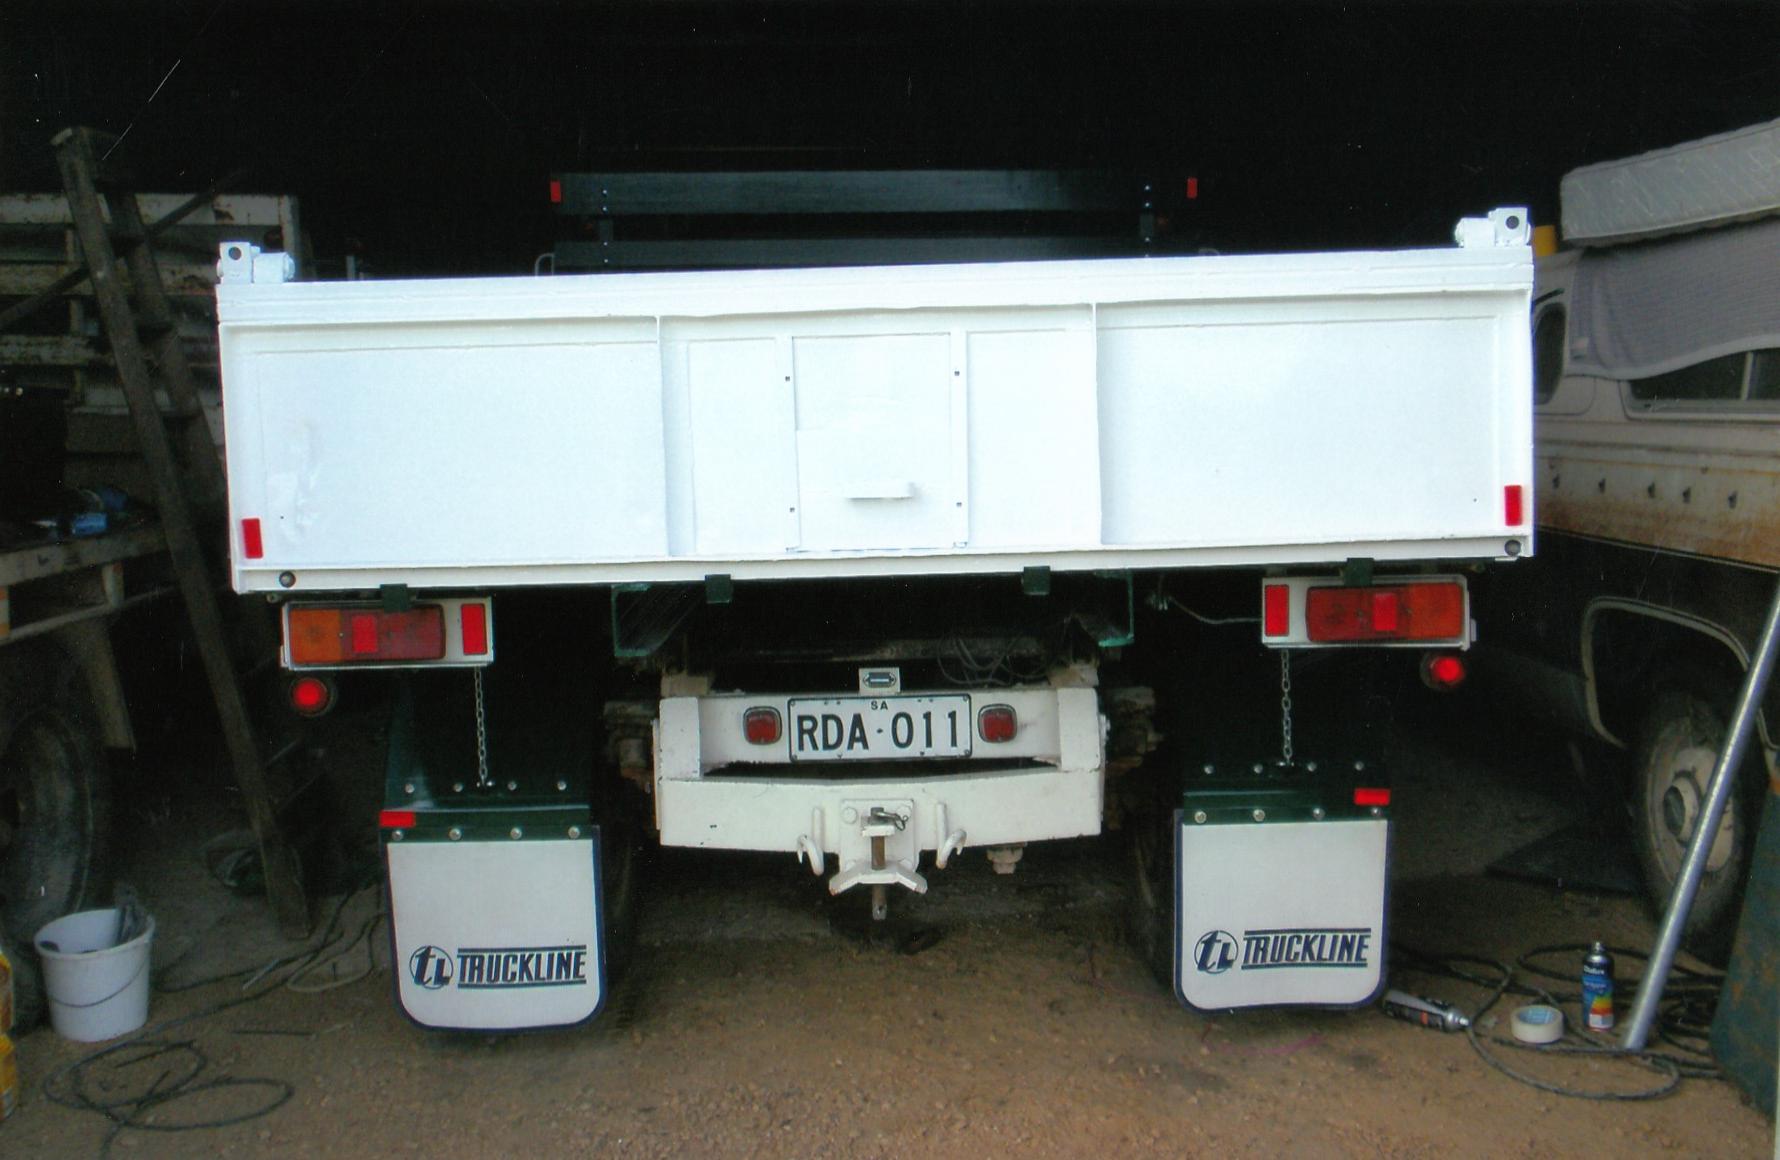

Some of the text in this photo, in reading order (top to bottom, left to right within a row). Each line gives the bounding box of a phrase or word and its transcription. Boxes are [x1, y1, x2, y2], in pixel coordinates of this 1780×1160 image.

[871, 700, 888, 710] SA
[1242, 934, 1371, 964] TRUCKLINE
[457, 951, 587, 983] TRUCKLINE
